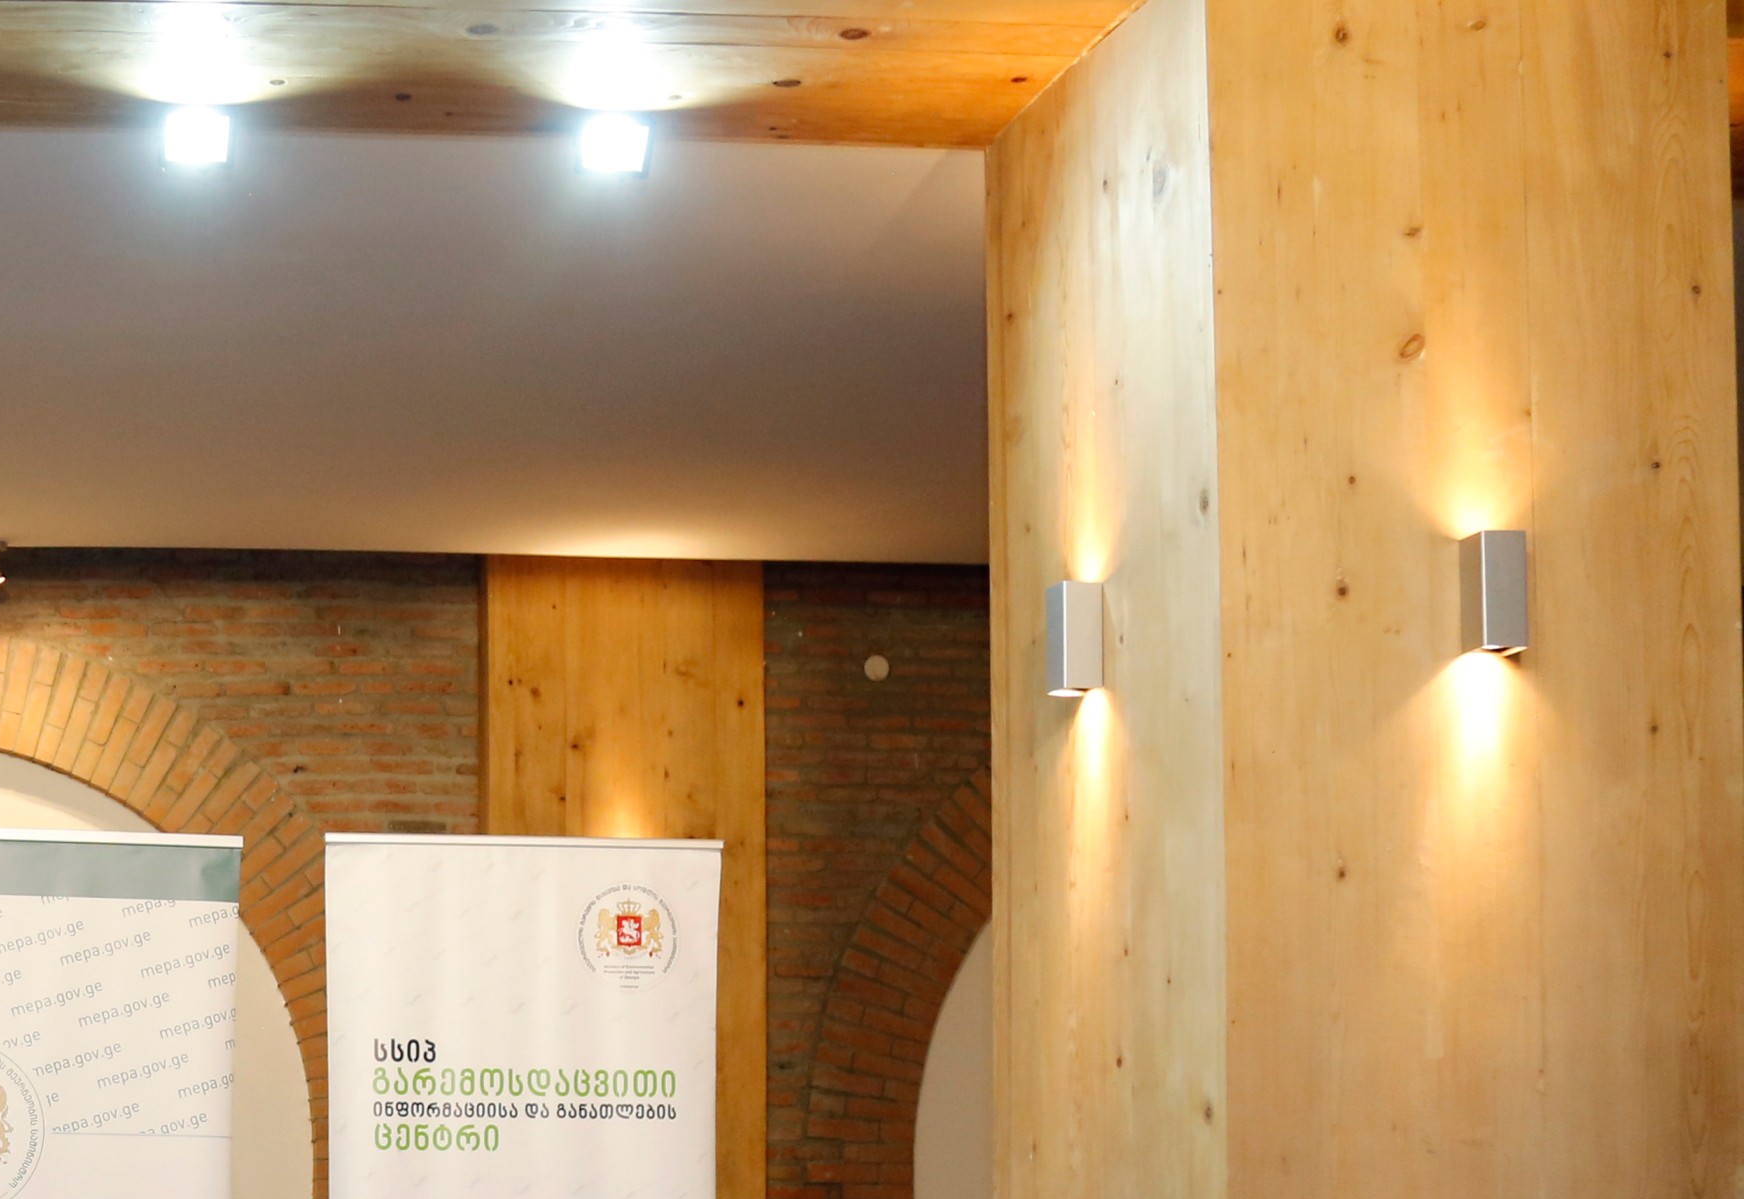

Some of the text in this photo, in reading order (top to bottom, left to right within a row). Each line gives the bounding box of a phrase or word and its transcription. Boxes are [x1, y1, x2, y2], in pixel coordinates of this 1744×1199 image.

[60, 930, 151, 966] mepa.gov.ge
[140, 942, 230, 978] mepa.gov.ge
[11, 980, 103, 1017] mepa.gov.ge
[78, 990, 170, 1027] mepa.gov.ge
[373, 1038, 436, 1063] სსიპ
[97, 1052, 189, 1089] mepa.gov.ge
[372, 1067, 676, 1098] გარემოსდაცვითი
[373, 1101, 677, 1120] ინფორმაციისა და განათლების
[374, 1123, 500, 1151] ცენტრი
